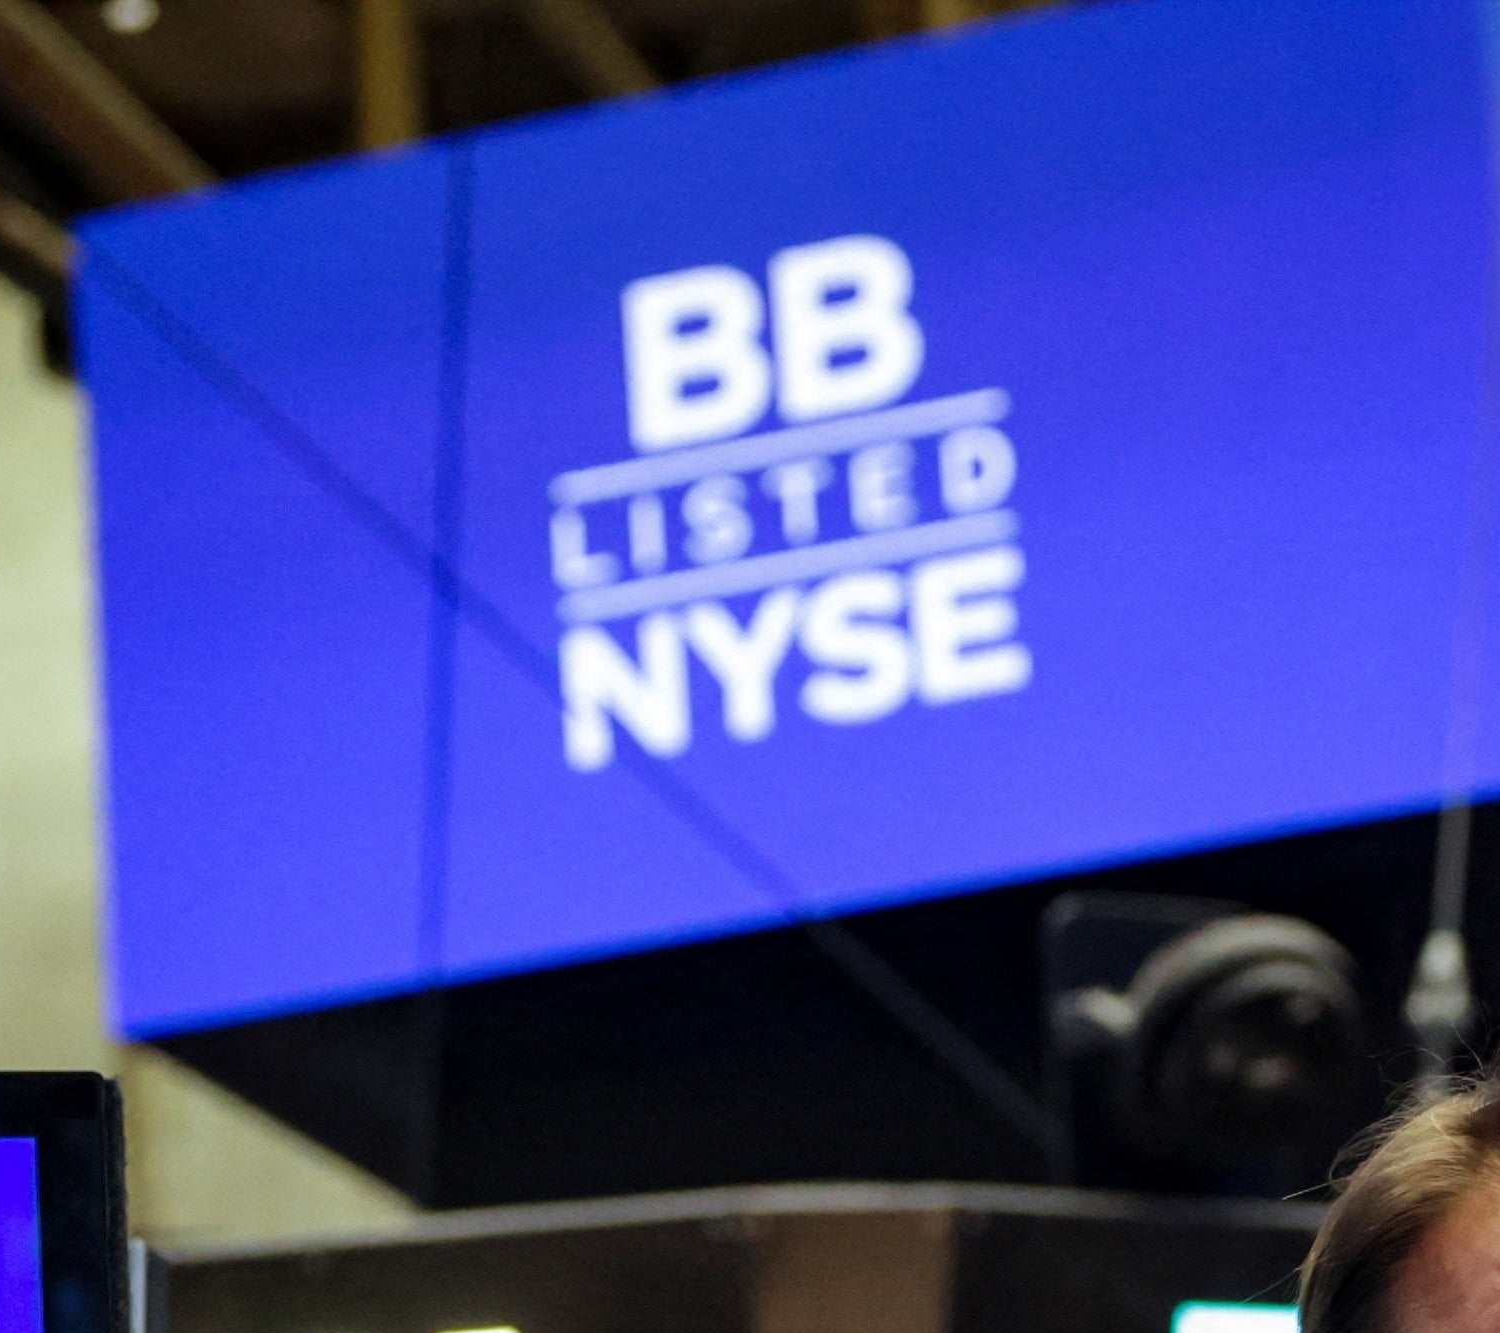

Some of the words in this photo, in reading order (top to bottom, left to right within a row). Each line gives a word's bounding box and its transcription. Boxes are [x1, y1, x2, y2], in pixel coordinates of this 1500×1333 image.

[620, 233, 925, 456] BB
[550, 425, 1018, 591] LISTED
[558, 542, 1033, 774] NYSE
